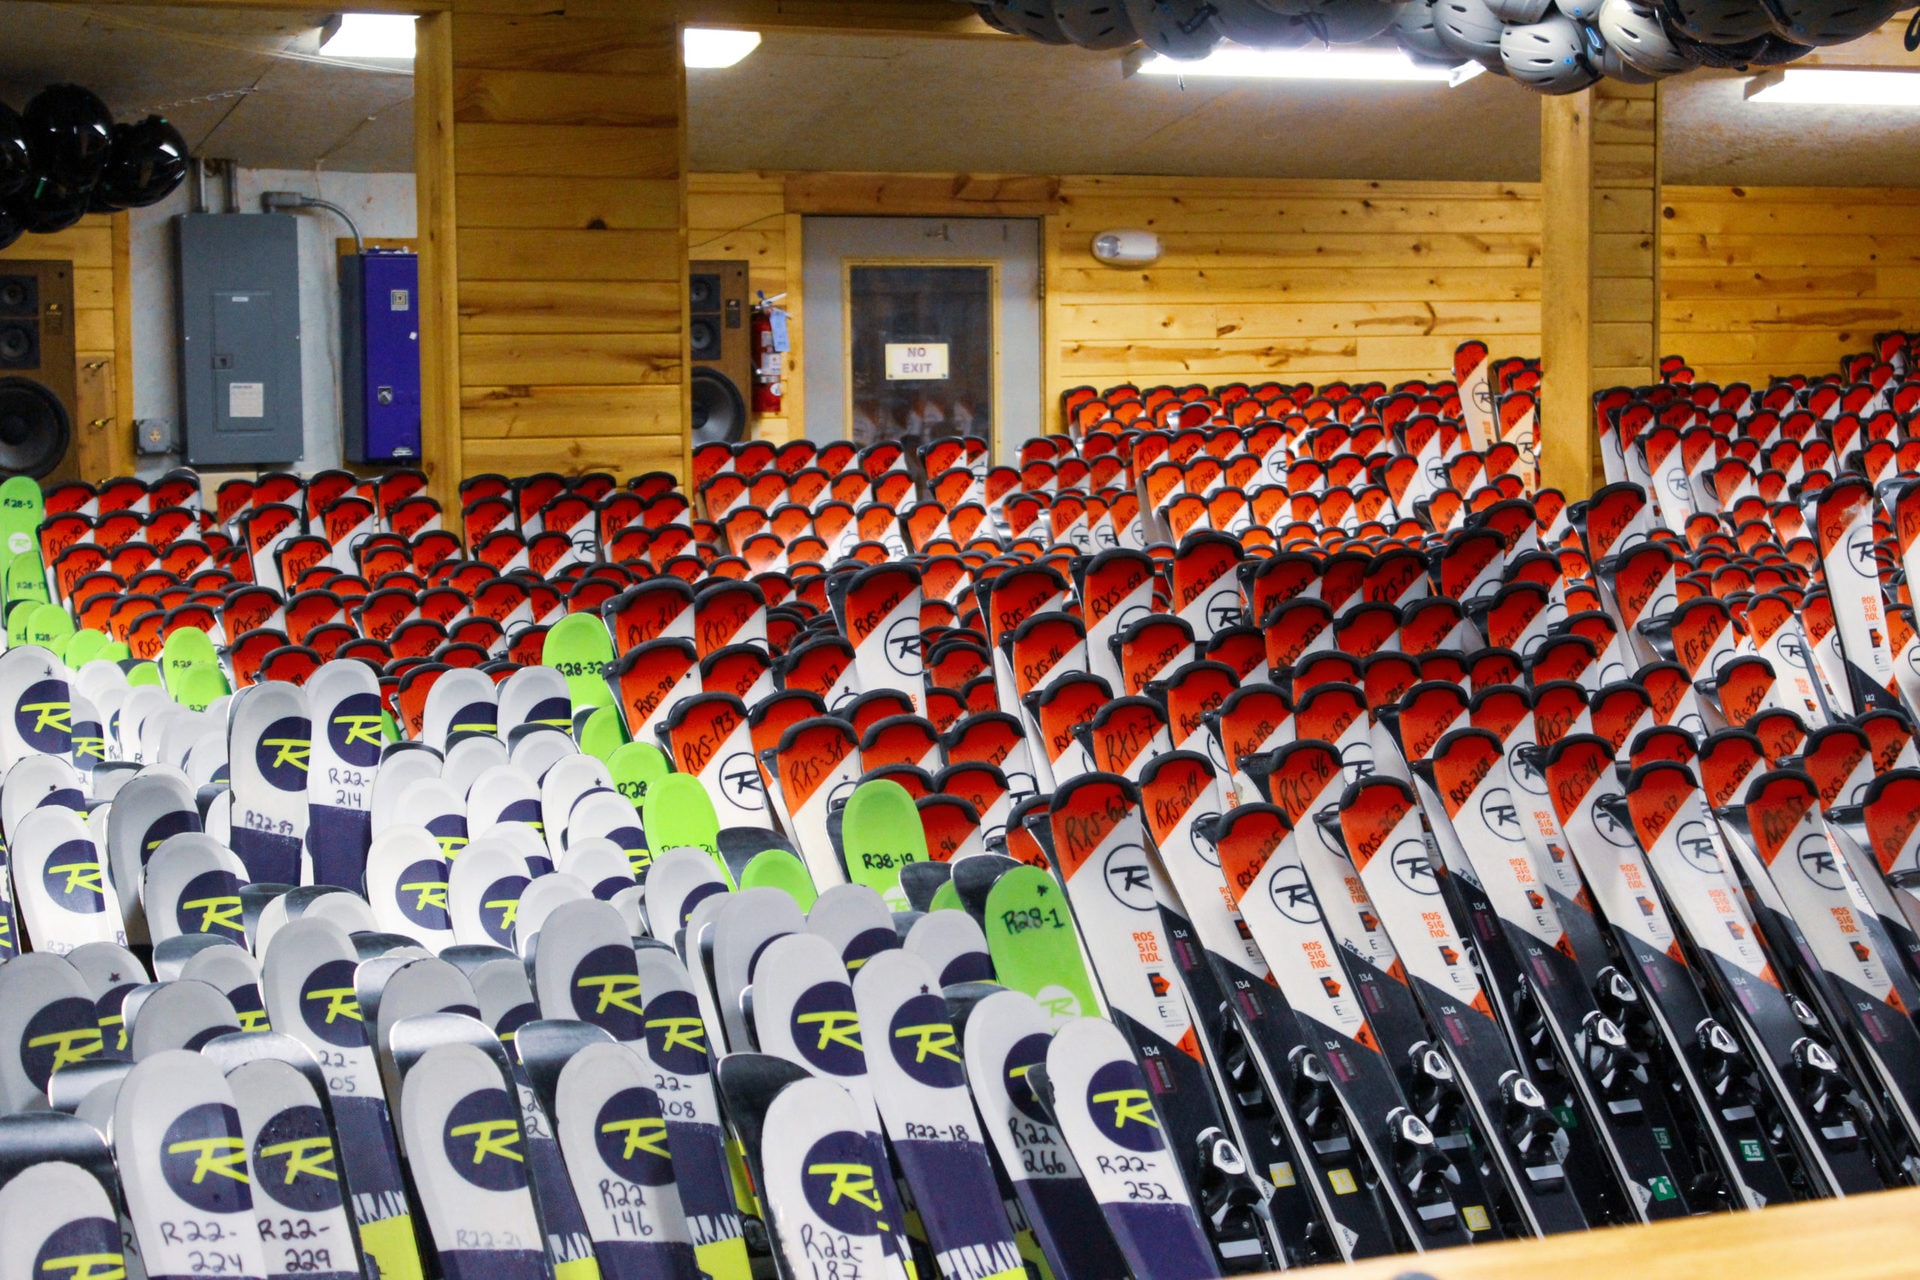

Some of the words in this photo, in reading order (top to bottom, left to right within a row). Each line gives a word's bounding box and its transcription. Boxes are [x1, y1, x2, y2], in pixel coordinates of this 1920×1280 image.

[907, 347, 926, 358] NO
[902, 363, 931, 373] EXIT
[328, 767, 370, 786] R22-
[335, 790, 362, 808] 214
[244, 809, 294, 836] R22-87
[863, 852, 915, 869] R28-19
[1421, 912, 1441, 920] ROS
[1830, 907, 1849, 915] ROS
[1001, 908, 1065, 935] R28-1
[1426, 921, 1445, 929] SIG
[1132, 932, 1155, 942] ROS
[1302, 941, 1322, 950] ROS
[1138, 942, 1158, 952] SIG
[1307, 951, 1326, 959] SIG
[906, 1122, 969, 1141] R22-18
[1009, 1117, 1056, 1148] R22
[1024, 1150, 1067, 1174] 266
[1099, 1156, 1156, 1174] R22-
[600, 1180, 645, 1208] R22
[1124, 1180, 1173, 1200] 252
[259, 1219, 330, 1241] R22-
[612, 1211, 652, 1236] 146
[160, 1222, 237, 1245] R22-
[801, 1224, 862, 1261] R22-
[188, 1252, 244, 1272] 224
[286, 1249, 332, 1272] 229
